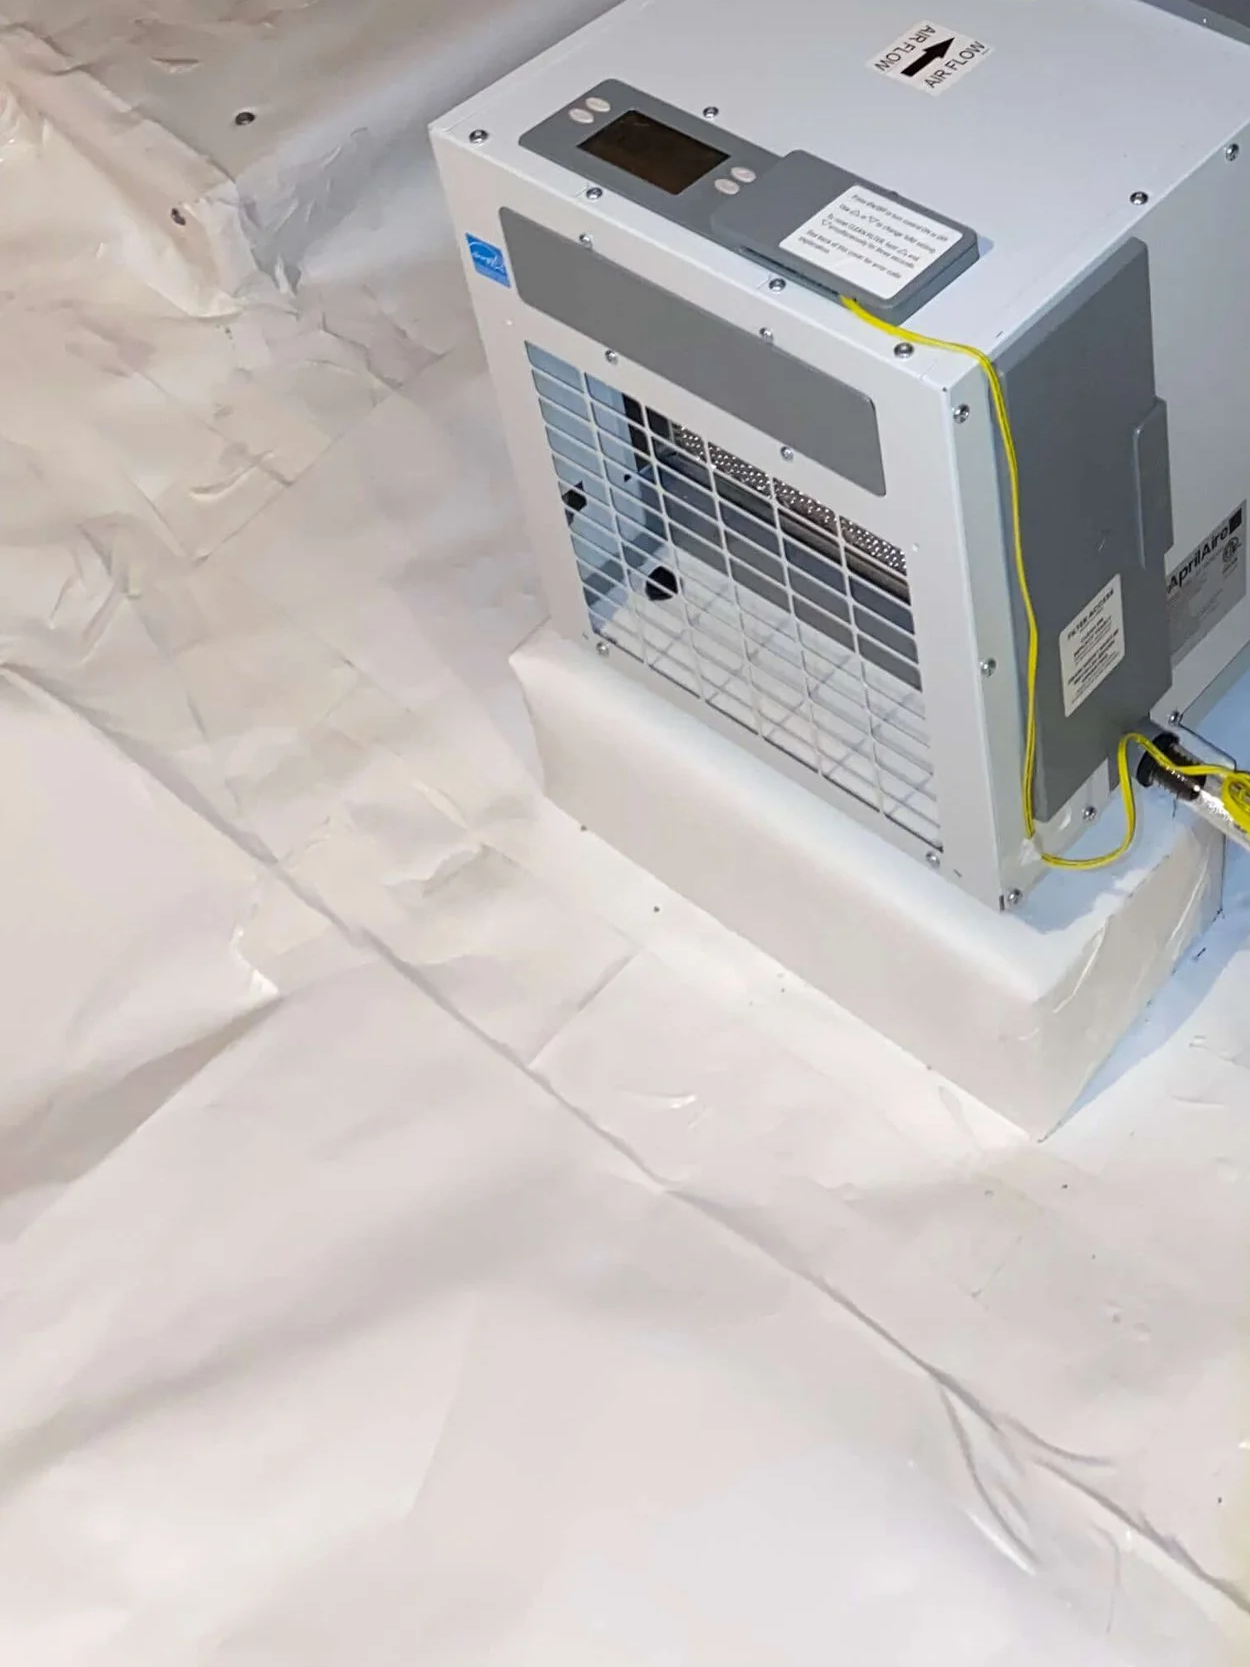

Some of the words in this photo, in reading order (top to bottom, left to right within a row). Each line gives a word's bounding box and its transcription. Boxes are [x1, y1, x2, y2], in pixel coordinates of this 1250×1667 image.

[909, 24, 936, 44] AIR
[874, 41, 917, 72] FLOW
[924, 69, 953, 89] AIR
[944, 40, 986, 72] FLOW
